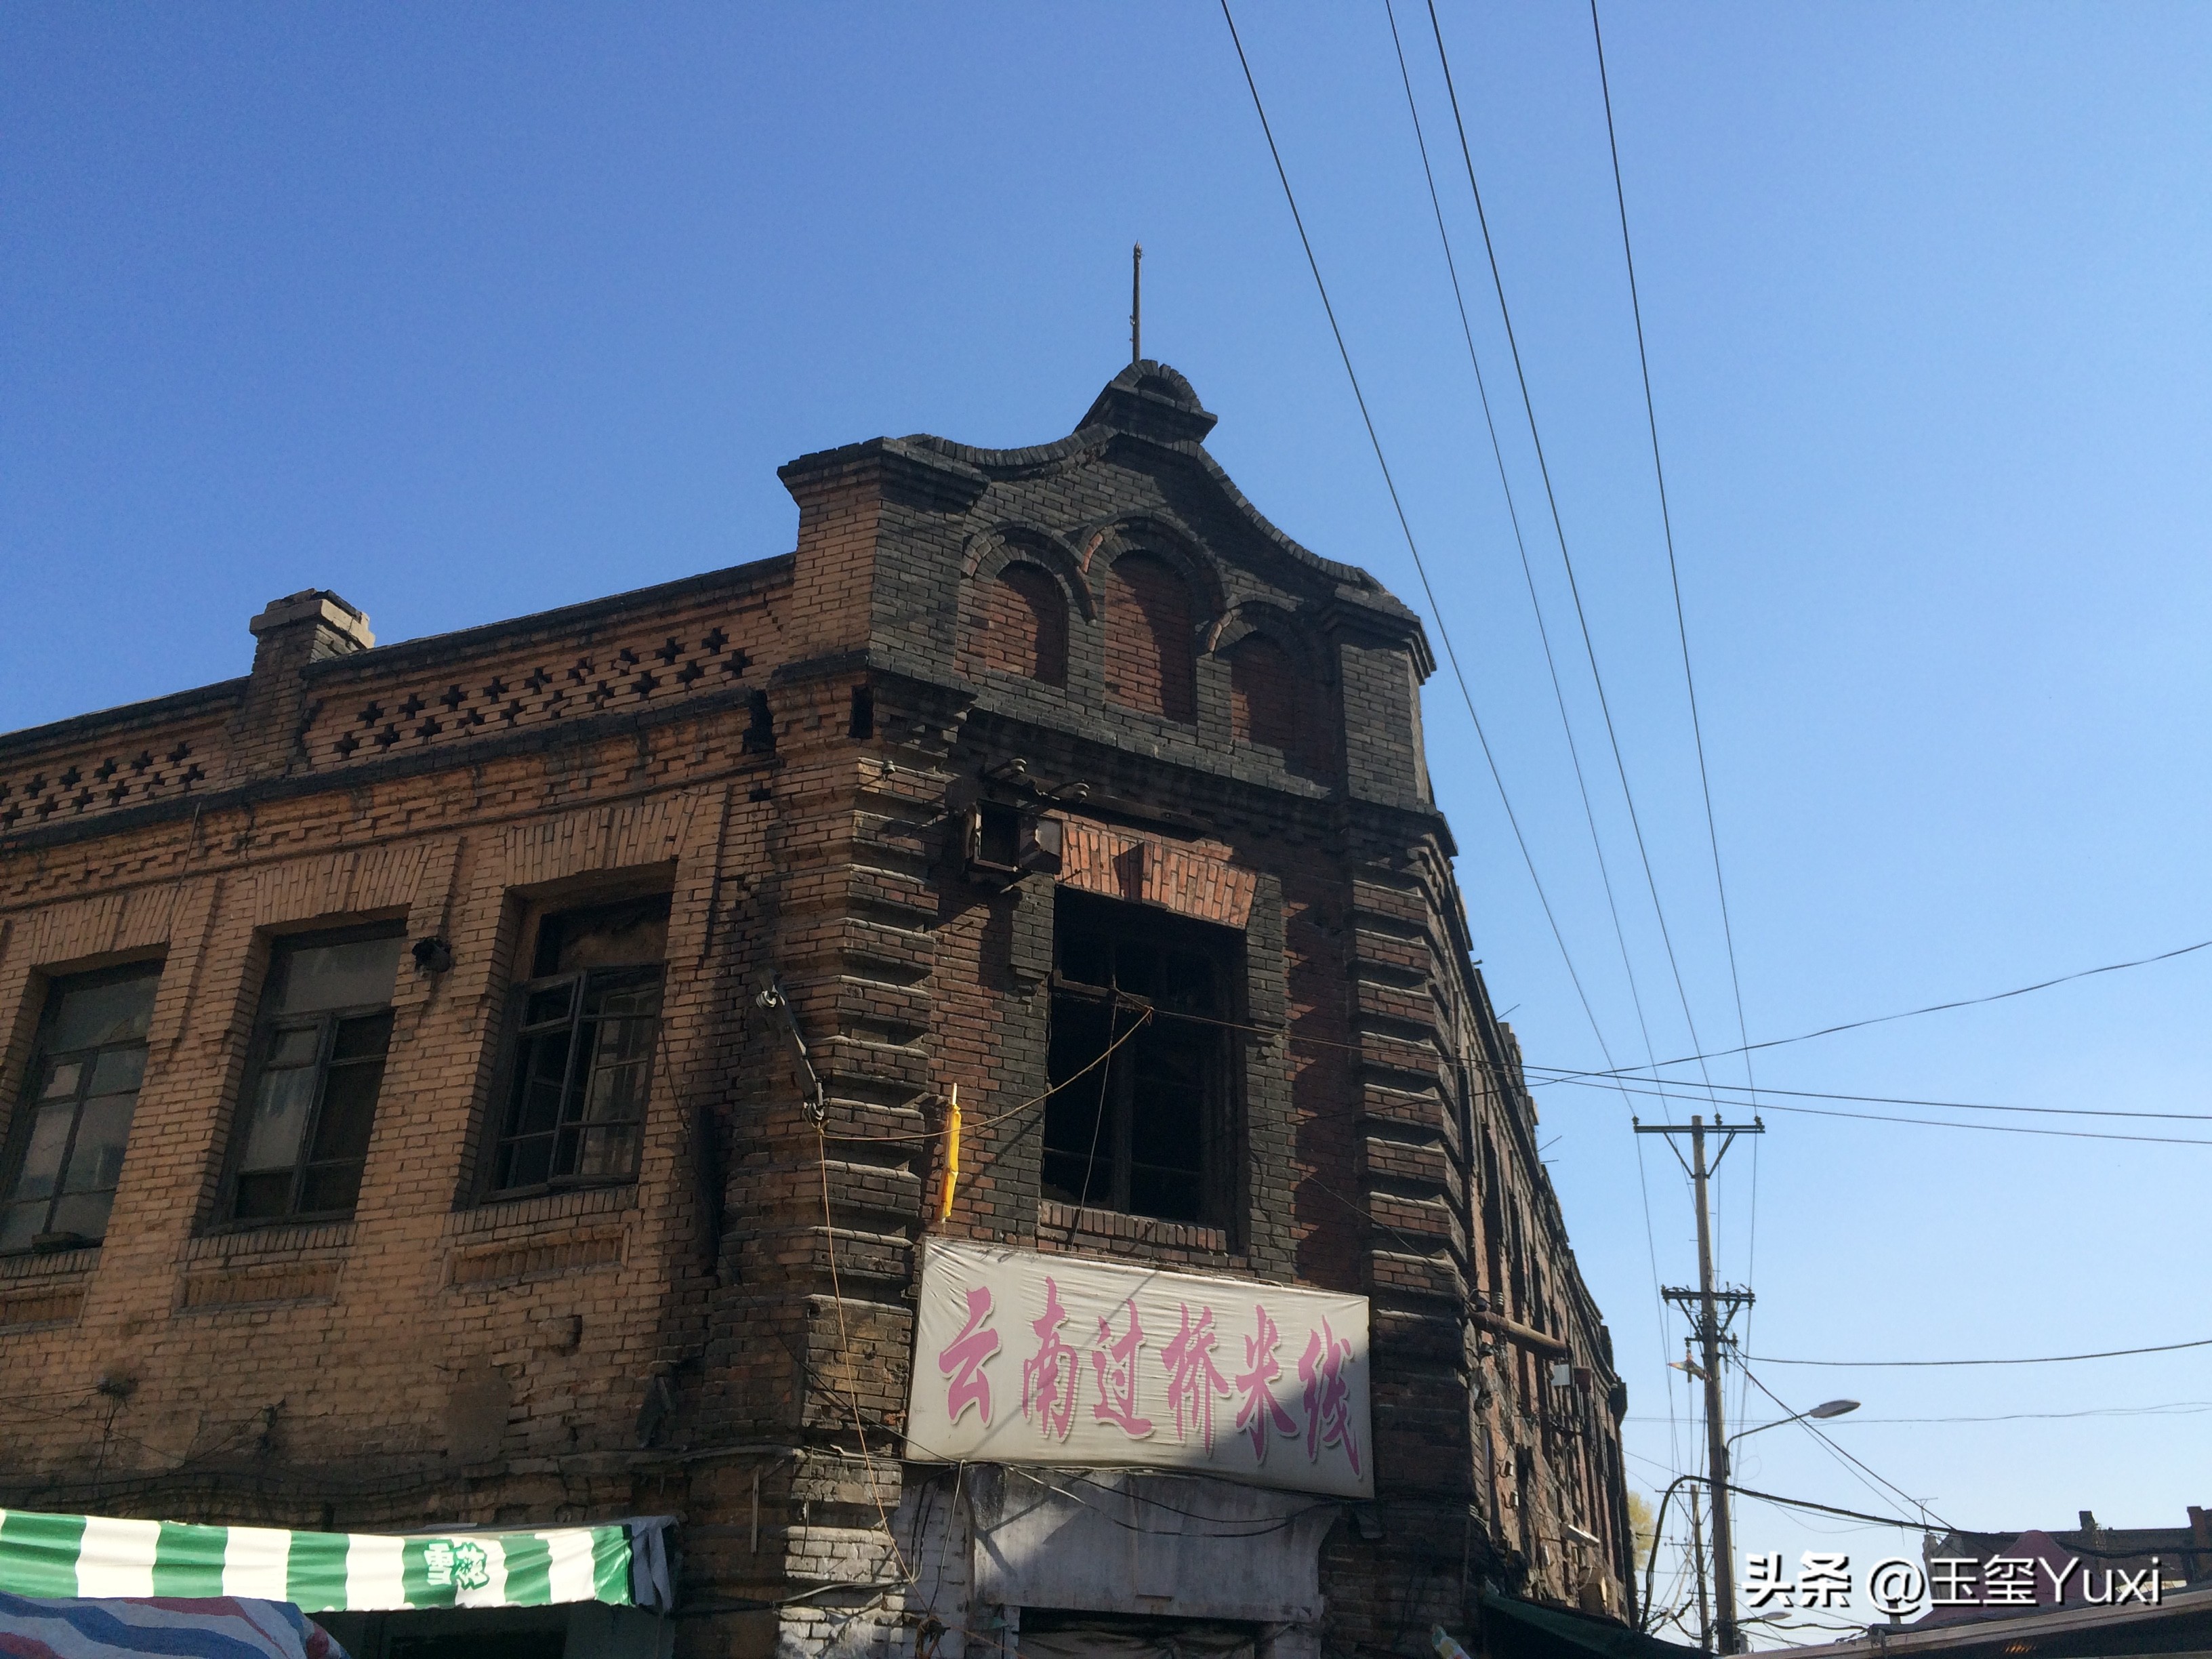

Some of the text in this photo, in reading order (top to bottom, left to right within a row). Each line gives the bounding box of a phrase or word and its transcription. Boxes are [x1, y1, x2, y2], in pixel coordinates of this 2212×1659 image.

[939, 1275, 1359, 1476] 云南过桥米线
